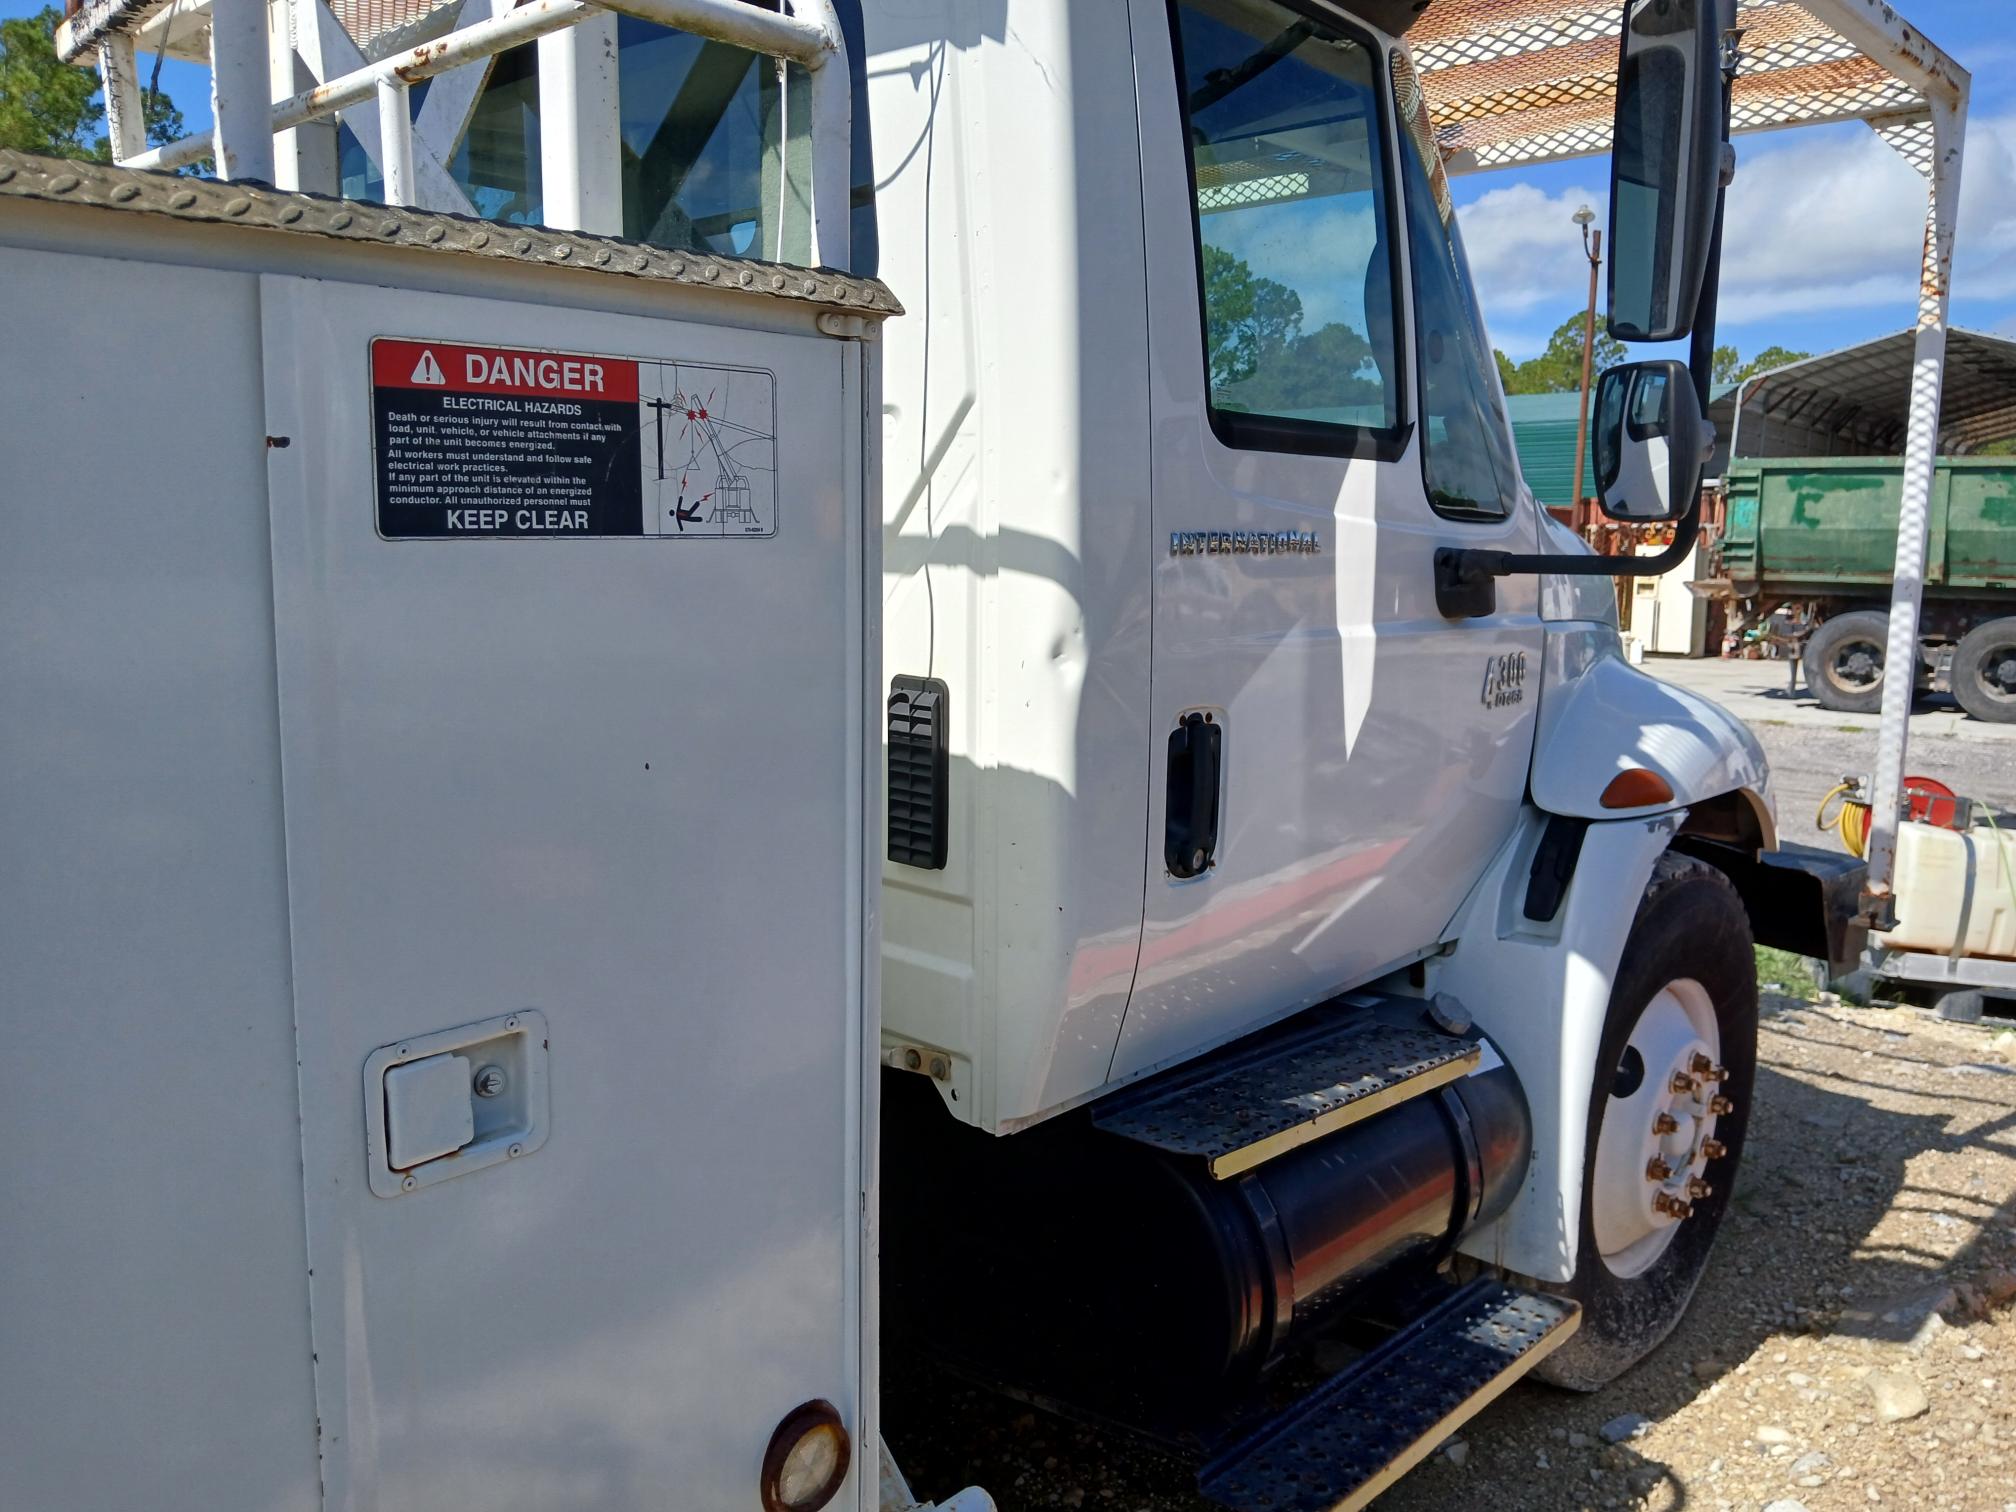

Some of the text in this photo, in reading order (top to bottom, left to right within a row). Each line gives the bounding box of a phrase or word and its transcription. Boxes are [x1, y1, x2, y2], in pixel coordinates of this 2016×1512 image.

[466, 353, 604, 392] DANGER
[443, 396, 582, 416] ELECTRICAL HAZARDS
[388, 412, 622, 432] Death or serious injury will result from contact with
[388, 424, 414, 434] load,
[440, 426, 478, 436] vehicle,
[492, 428, 525, 438] vehicle
[528, 431, 580, 440] attachments
[582, 432, 590, 440] if
[591, 434, 607, 443] any
[389, 436, 556, 450] part of the unit becomes energized.
[388, 450, 402, 458] All
[404, 450, 443, 460] workers
[446, 452, 470, 460] must
[472, 452, 524, 462] understand
[545, 454, 572, 463] follow
[574, 456, 592, 464] safe
[388, 461, 508, 472] electrical work practices.
[388, 472, 587, 485] If any part of the unit is elevated within the
[389, 484, 434, 493] minimum
[436, 485, 480, 494] approach
[484, 486, 523, 494] distance
[525, 486, 534, 494] of
[550, 488, 592, 496] energized
[389, 496, 591, 506] conductor. All unauthorized personnel must
[447, 509, 589, 530] KEEP CLEAR
[1170, 531, 1321, 556] INTERNATIONAL
